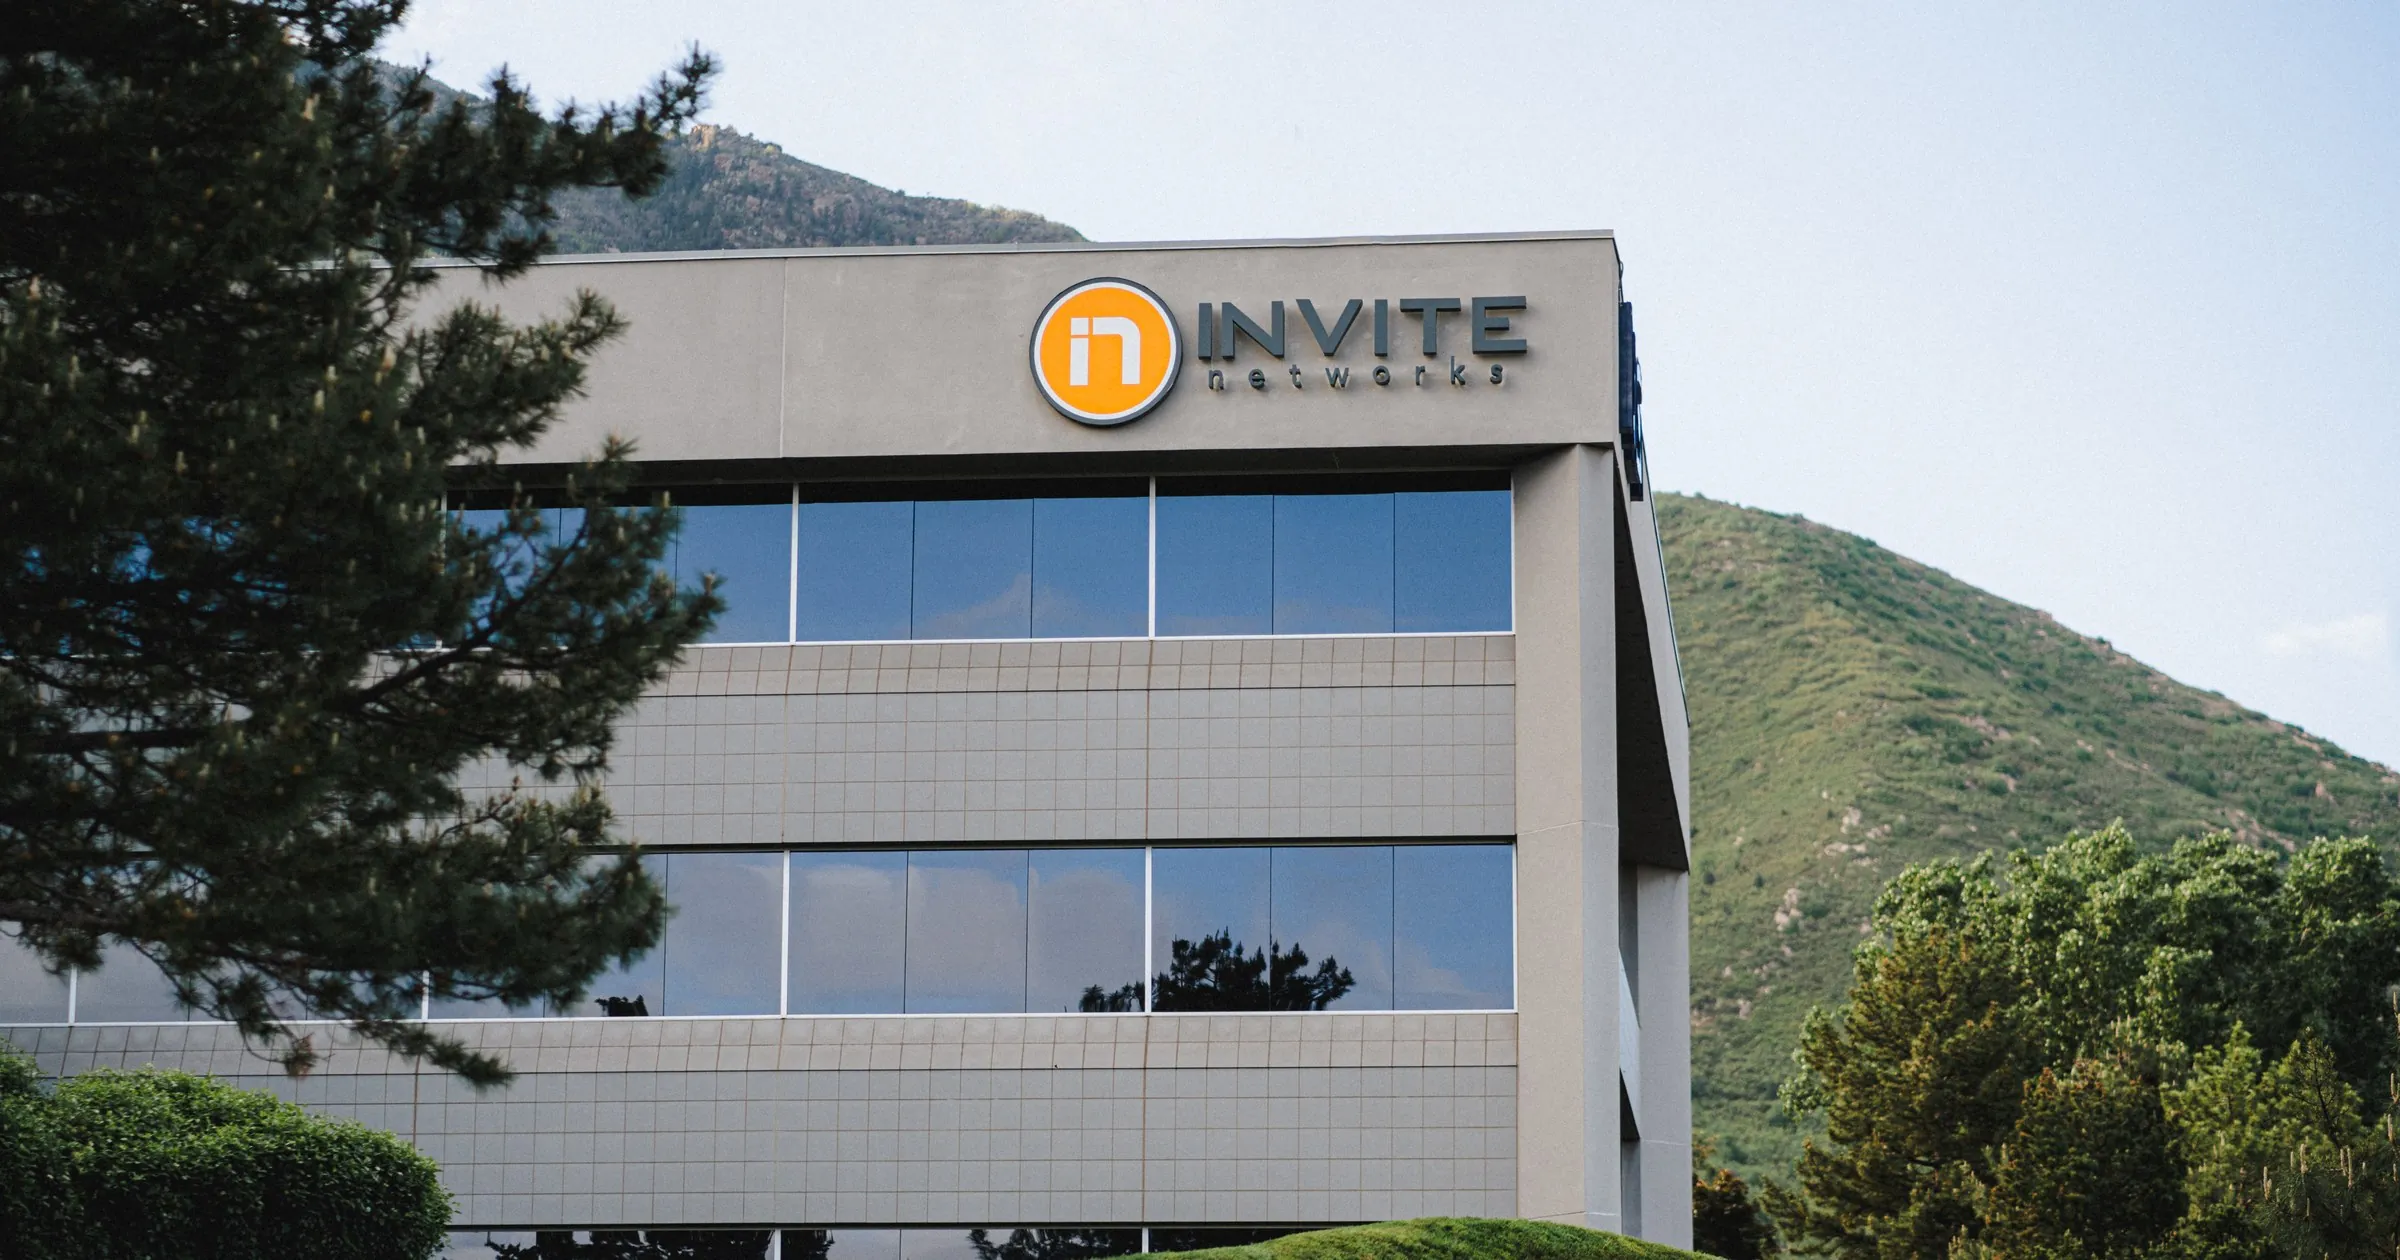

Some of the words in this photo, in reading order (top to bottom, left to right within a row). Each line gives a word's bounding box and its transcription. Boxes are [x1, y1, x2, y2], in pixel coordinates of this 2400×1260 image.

[1069, 317, 1141, 386] in
[1197, 296, 1528, 360] INVITE
[1208, 356, 1504, 390] networks
